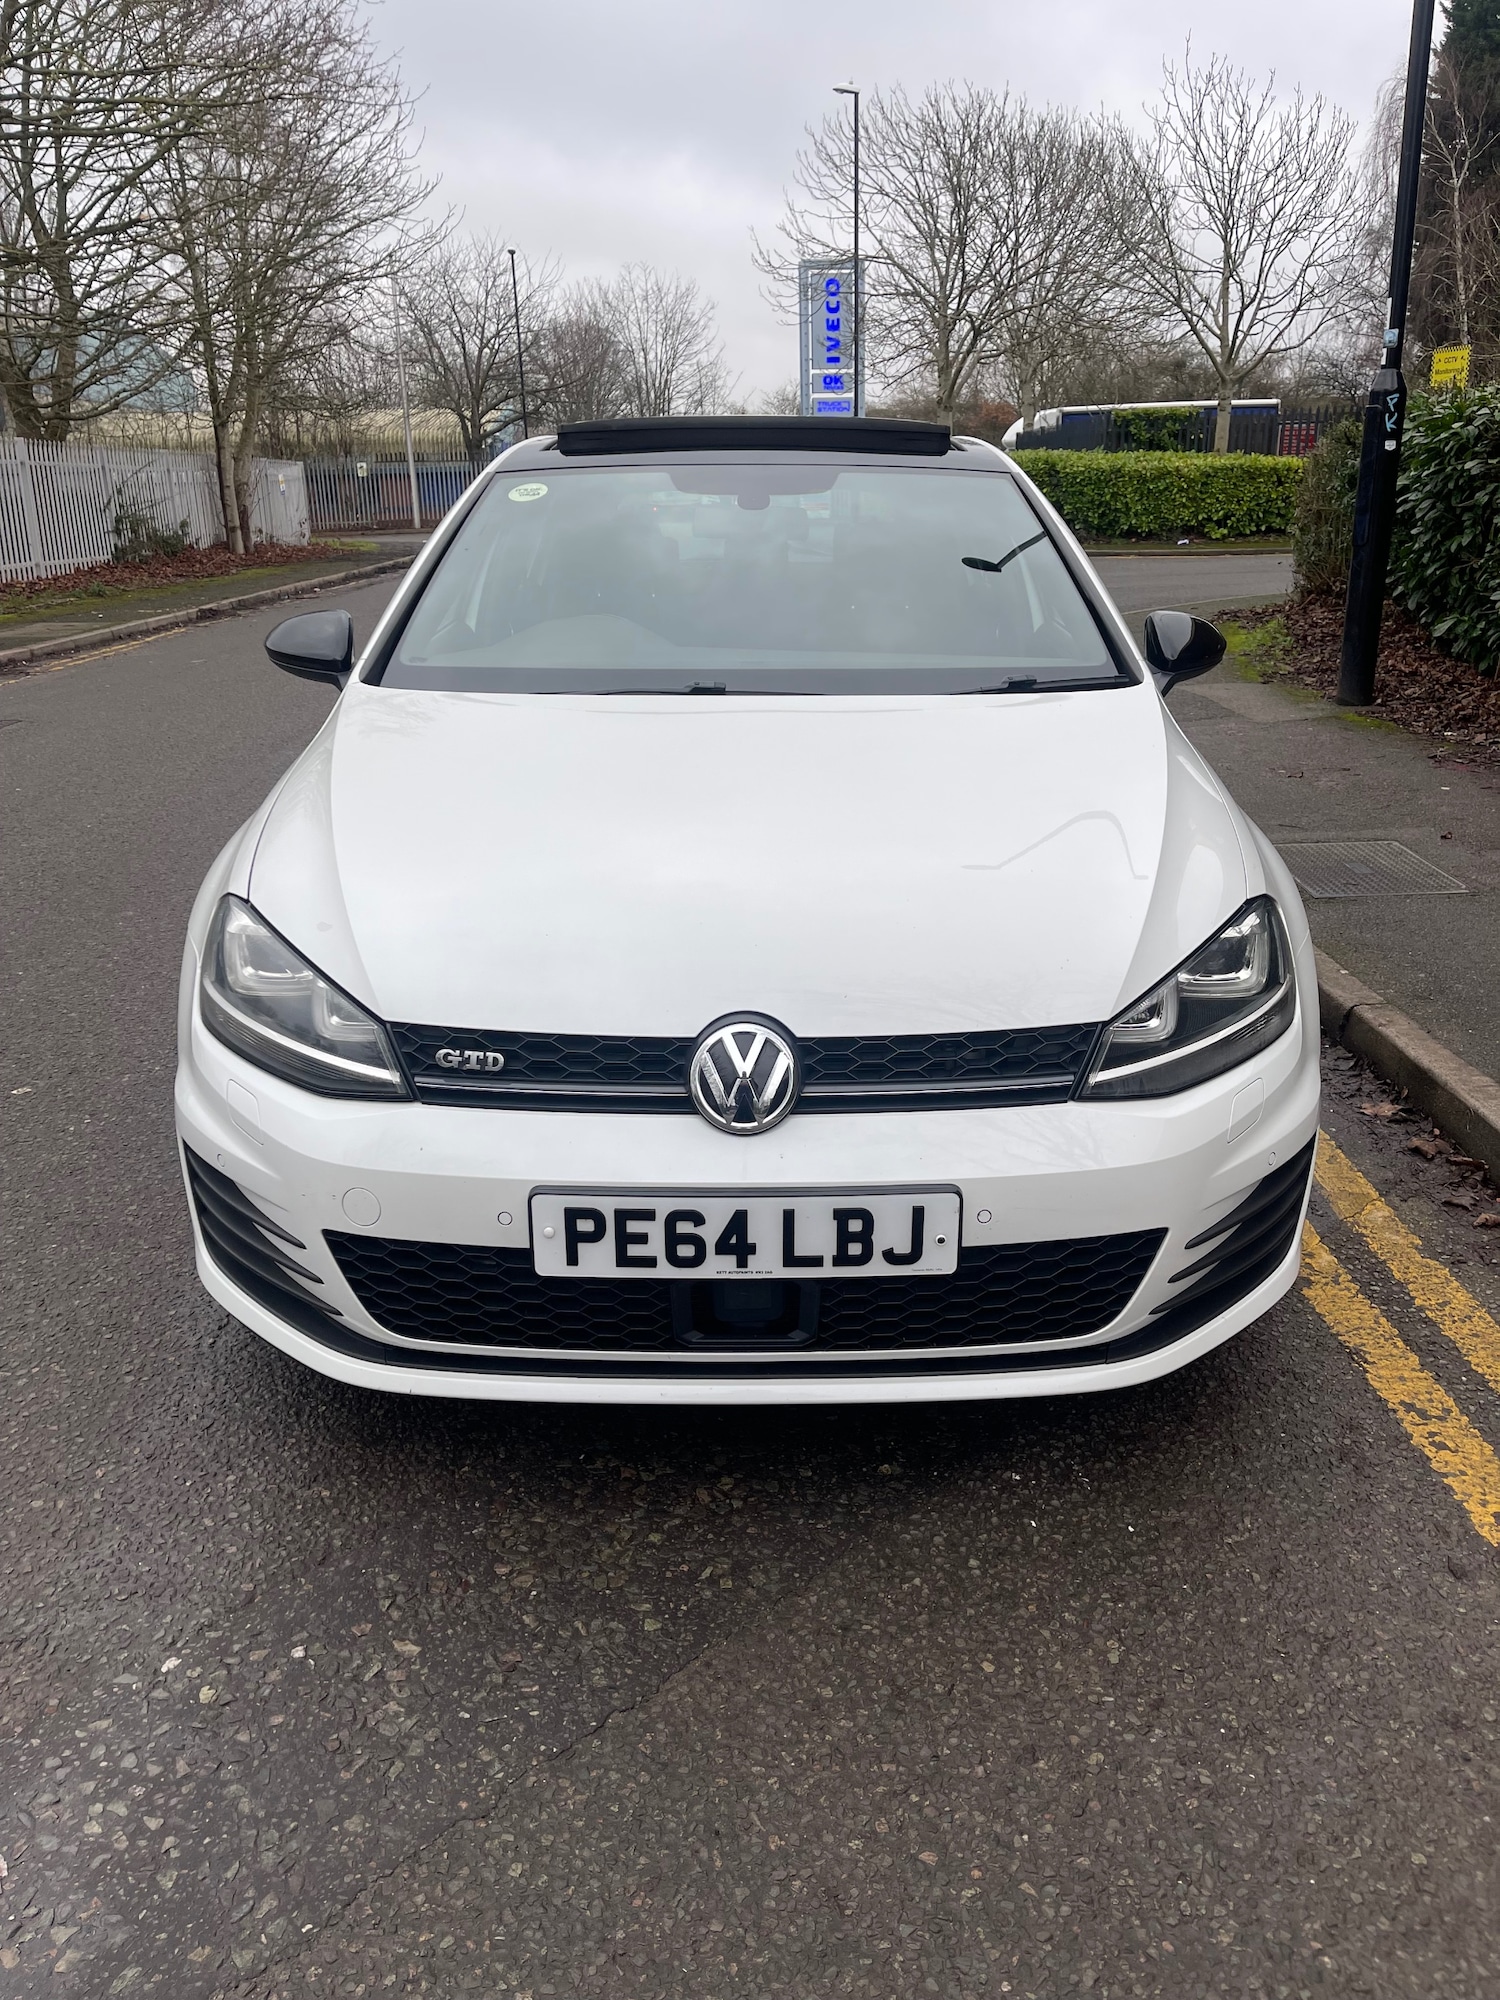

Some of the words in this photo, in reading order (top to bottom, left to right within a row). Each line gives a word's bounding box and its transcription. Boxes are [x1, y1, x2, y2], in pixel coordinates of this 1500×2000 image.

[826, 278, 841, 364] IVECO
[1443, 356, 1458, 364] CCTV
[822, 374, 844, 386] OK
[435, 1049, 505, 1072] GTD
[563, 1206, 757, 1269] PE64
[782, 1205, 925, 1268] LBJ
